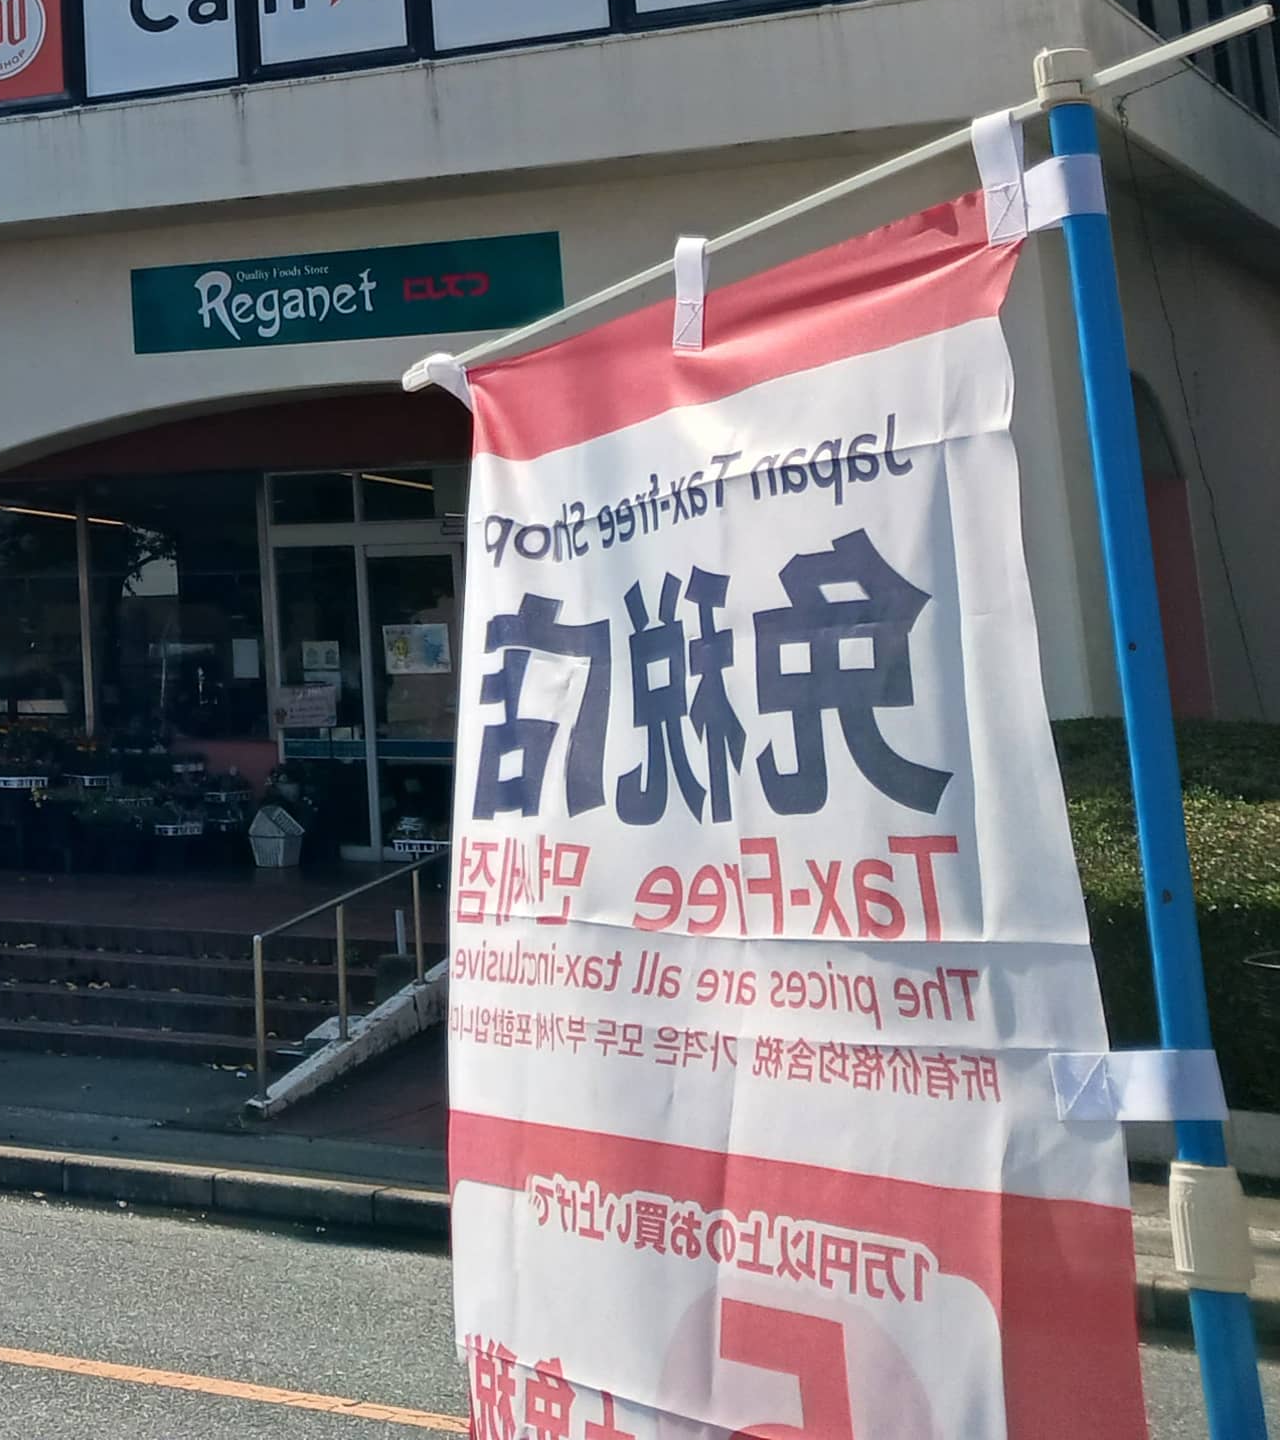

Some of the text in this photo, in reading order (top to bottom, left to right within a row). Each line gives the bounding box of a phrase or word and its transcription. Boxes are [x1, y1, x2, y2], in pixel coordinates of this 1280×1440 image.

[236, 263, 329, 283] Quality Foods Store
[193, 267, 378, 341] Reganet
